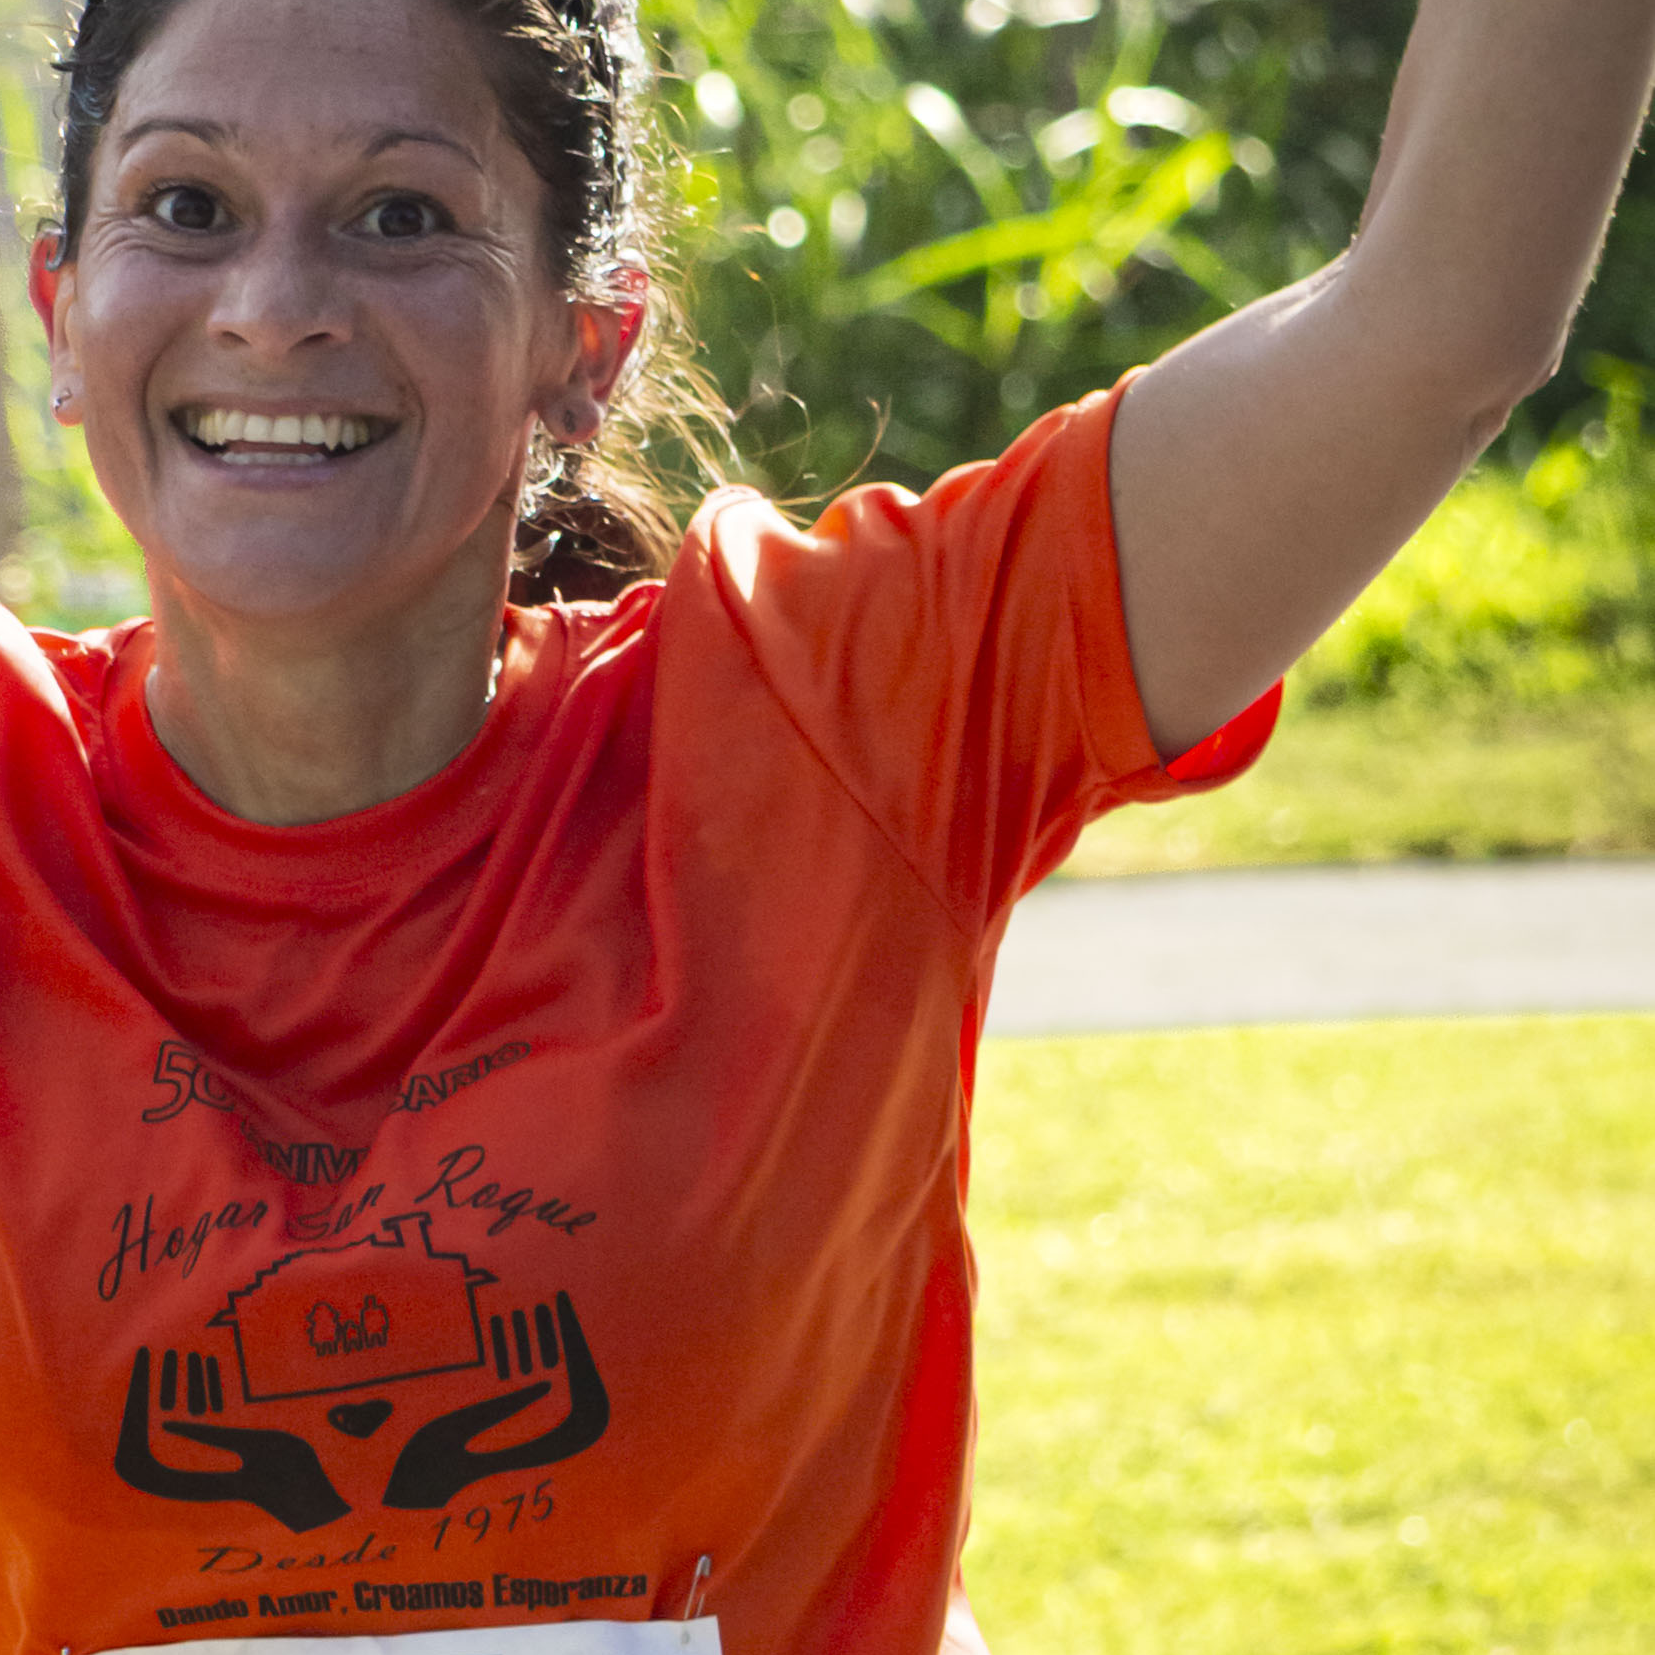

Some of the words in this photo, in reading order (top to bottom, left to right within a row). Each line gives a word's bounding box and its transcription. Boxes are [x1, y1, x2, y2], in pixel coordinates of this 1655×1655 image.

[98, 1194, 268, 1301] Hogar
[197, 1533, 396, 1572] Desde
[431, 1479, 554, 1551] 1975
[156, 1594, 248, 1629] Dando
[353, 1576, 484, 1612] Creamos
[494, 1573, 647, 1611] Esperanza
